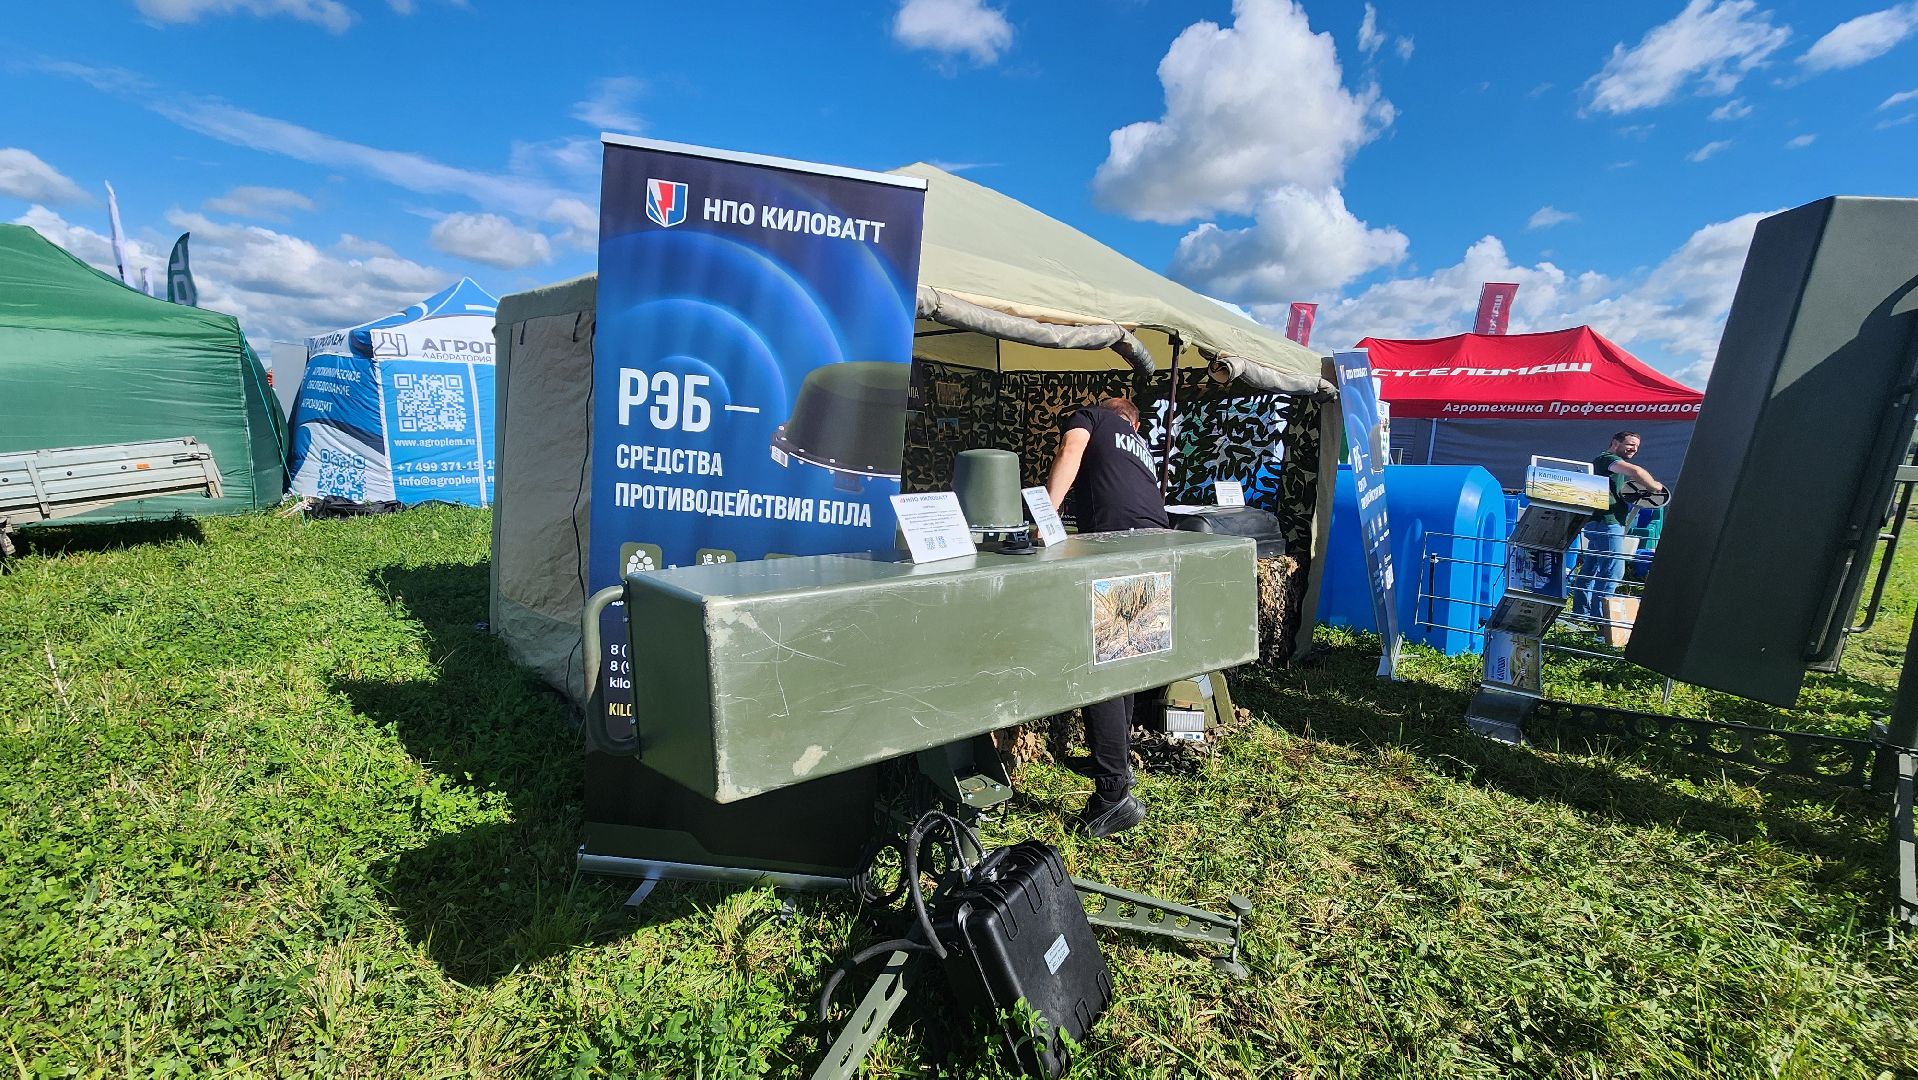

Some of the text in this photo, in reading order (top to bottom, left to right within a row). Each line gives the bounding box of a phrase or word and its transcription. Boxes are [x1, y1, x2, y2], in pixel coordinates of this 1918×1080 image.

[703, 197, 886, 244] НПО КИЛОВАТТ
[422, 351, 492, 363] ЛАБОРАТОРИЯ
[618, 367, 711, 433] РЭБ
[1442, 401, 1544, 414] Агротехника
[394, 437, 476, 448] www.agroplem.ru
[397, 462, 412, 473] +7
[415, 461, 438, 472] 499
[616, 443, 723, 477] СРЕДСТВА
[615, 482, 814, 523] ПРОТИВОДЕЙСТВИЯ
[818, 500, 872, 528] БПЛА
